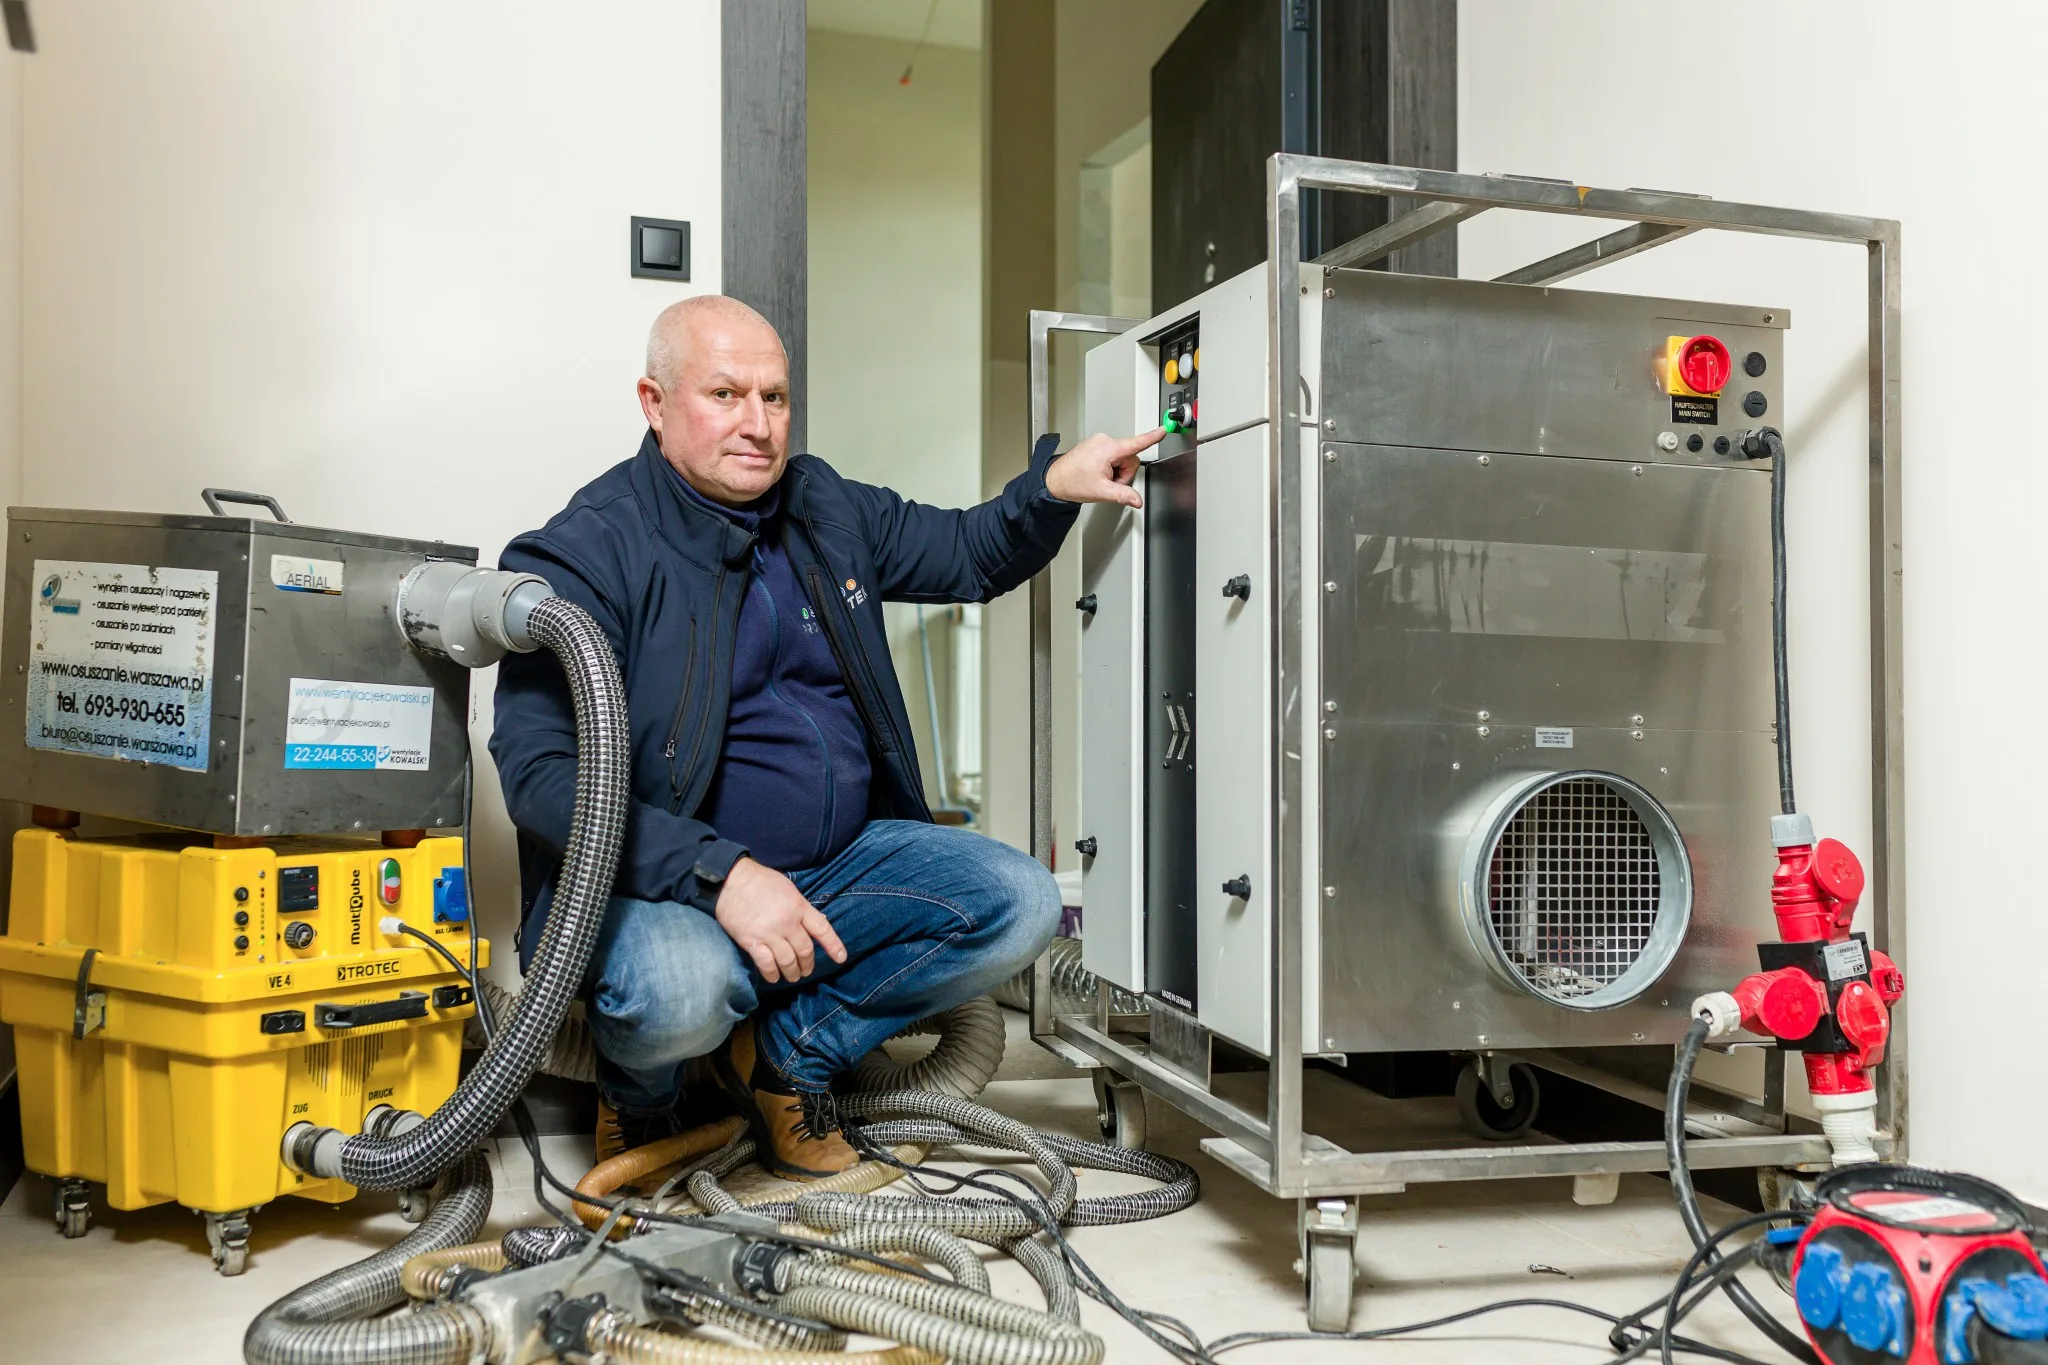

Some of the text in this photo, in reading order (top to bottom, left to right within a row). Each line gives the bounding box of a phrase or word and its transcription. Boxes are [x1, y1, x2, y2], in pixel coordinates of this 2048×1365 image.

[1692, 411, 1711, 419] SWITCH
[286, 573, 331, 590] AERIAL
[97, 600, 130, 611] osuszanie
[161, 606, 176, 616] pod
[96, 619, 129, 630] osuszanie
[130, 622, 140, 632] po
[94, 640, 124, 652] pomiary
[41, 661, 204, 691] www.osuszanie.warszawa.pl
[294, 686, 431, 706] www.wentylacjekowalski.pl
[56, 691, 185, 727] tel. 693-930-655
[41, 723, 198, 759] biuro@osuszanie.warszawa.pl
[293, 746, 376, 763] 22-244-55-36
[390, 755, 427, 765] KOWALSKI
[391, 748, 421, 757] wentylacje
[346, 961, 400, 979] TROTEC
[268, 974, 292, 988] VE 4
[368, 1087, 394, 1101] DRUCK
[292, 1102, 309, 1114] ZUG
